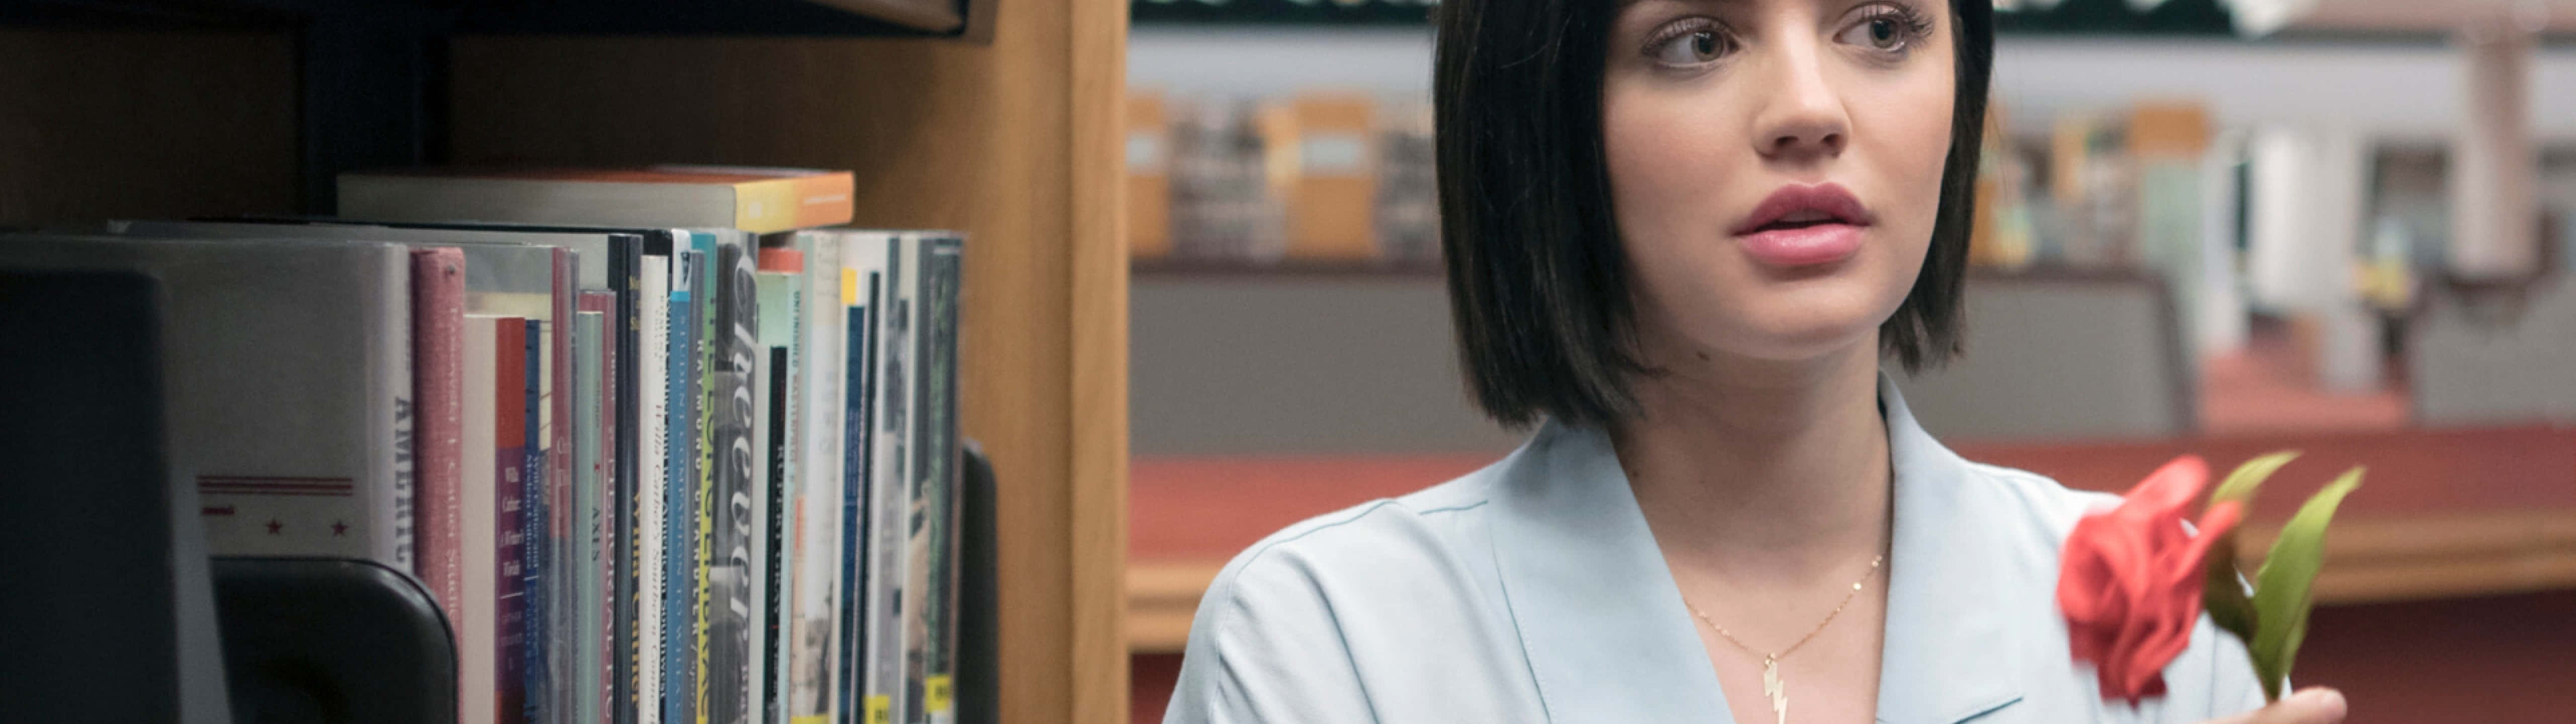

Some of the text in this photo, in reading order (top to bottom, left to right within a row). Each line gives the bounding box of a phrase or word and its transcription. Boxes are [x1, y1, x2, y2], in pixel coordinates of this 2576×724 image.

[654, 405, 663, 456] Willa
[729, 255, 757, 640] Cheever
[592, 506, 601, 562] AXES
[692, 339, 704, 636] RAYMOND CHANDLER
[775, 445, 784, 541] RUPERT
[631, 492, 641, 704] Willa Cather
[676, 587, 682, 616] TO
